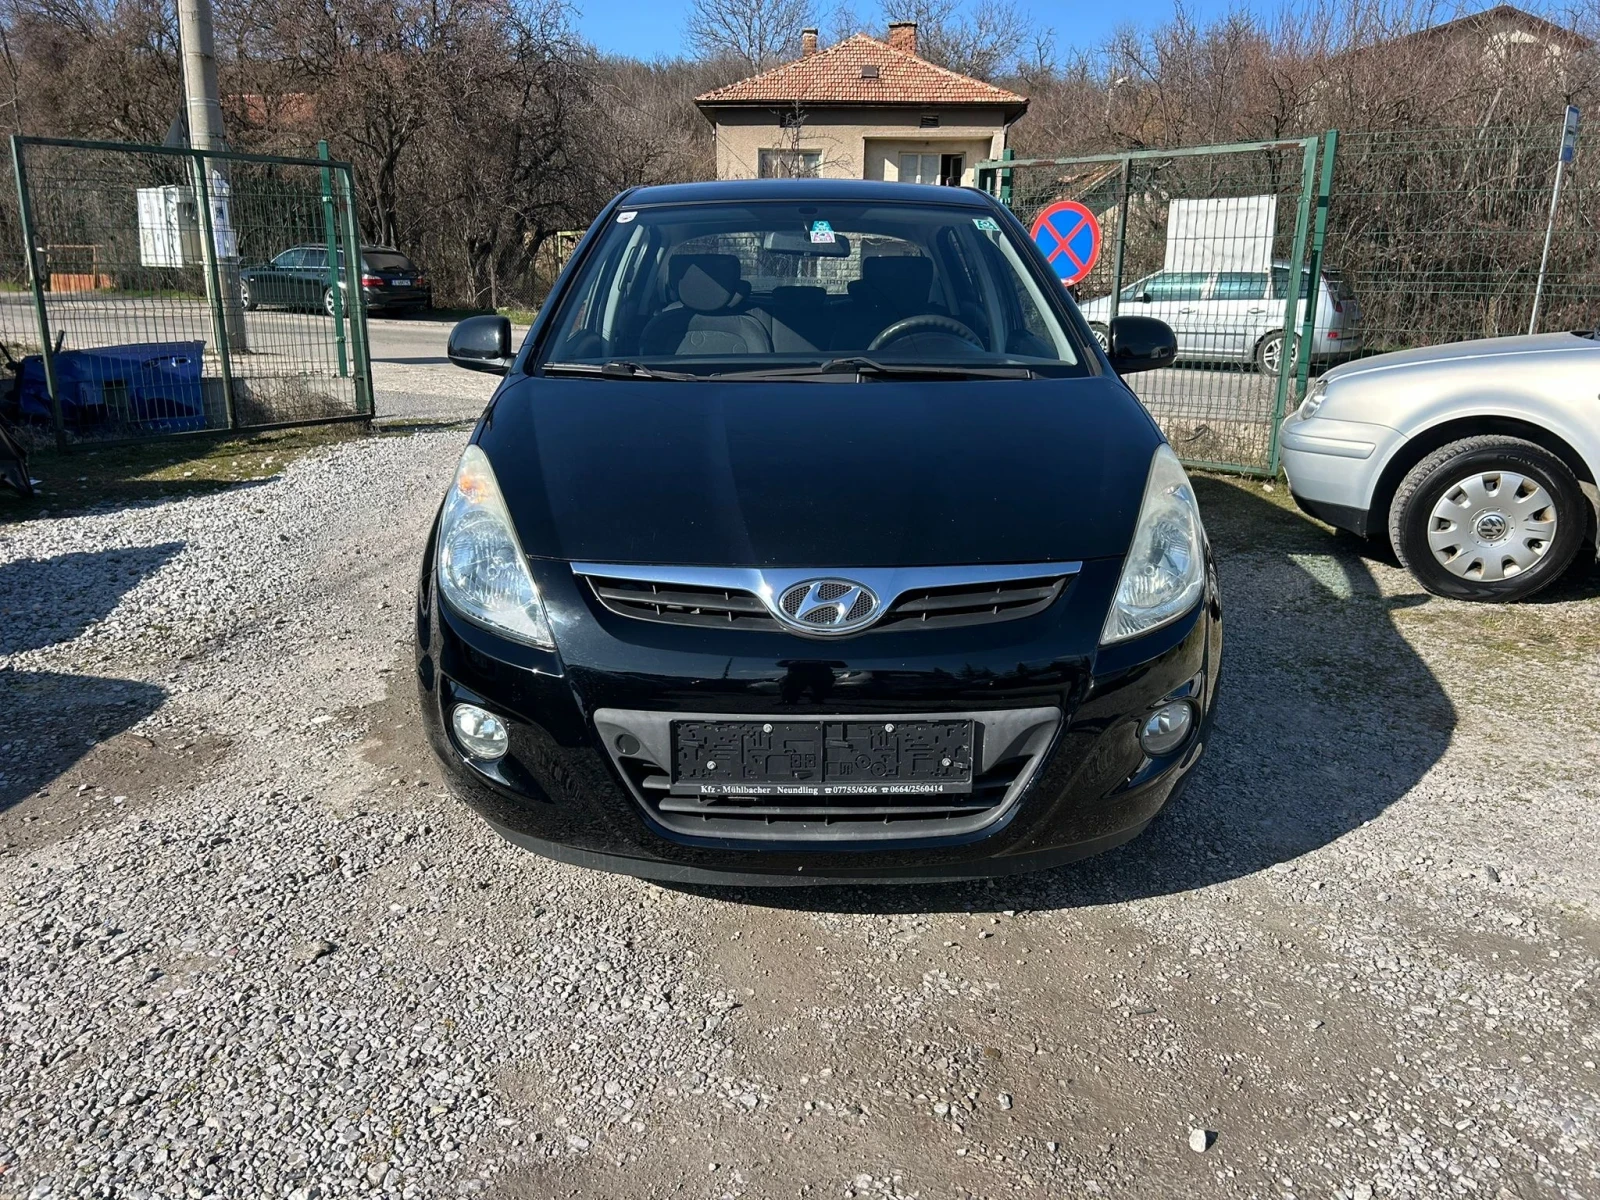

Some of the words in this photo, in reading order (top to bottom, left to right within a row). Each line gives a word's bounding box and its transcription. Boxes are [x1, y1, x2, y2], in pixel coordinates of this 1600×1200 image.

[700, 785, 716, 793] Kfz
[722, 785, 771, 794] Mühlbacher
[777, 786, 819, 795] Neundling
[832, 785, 878, 794] 07755/6266
[890, 784, 944, 793] 0664/2560414
